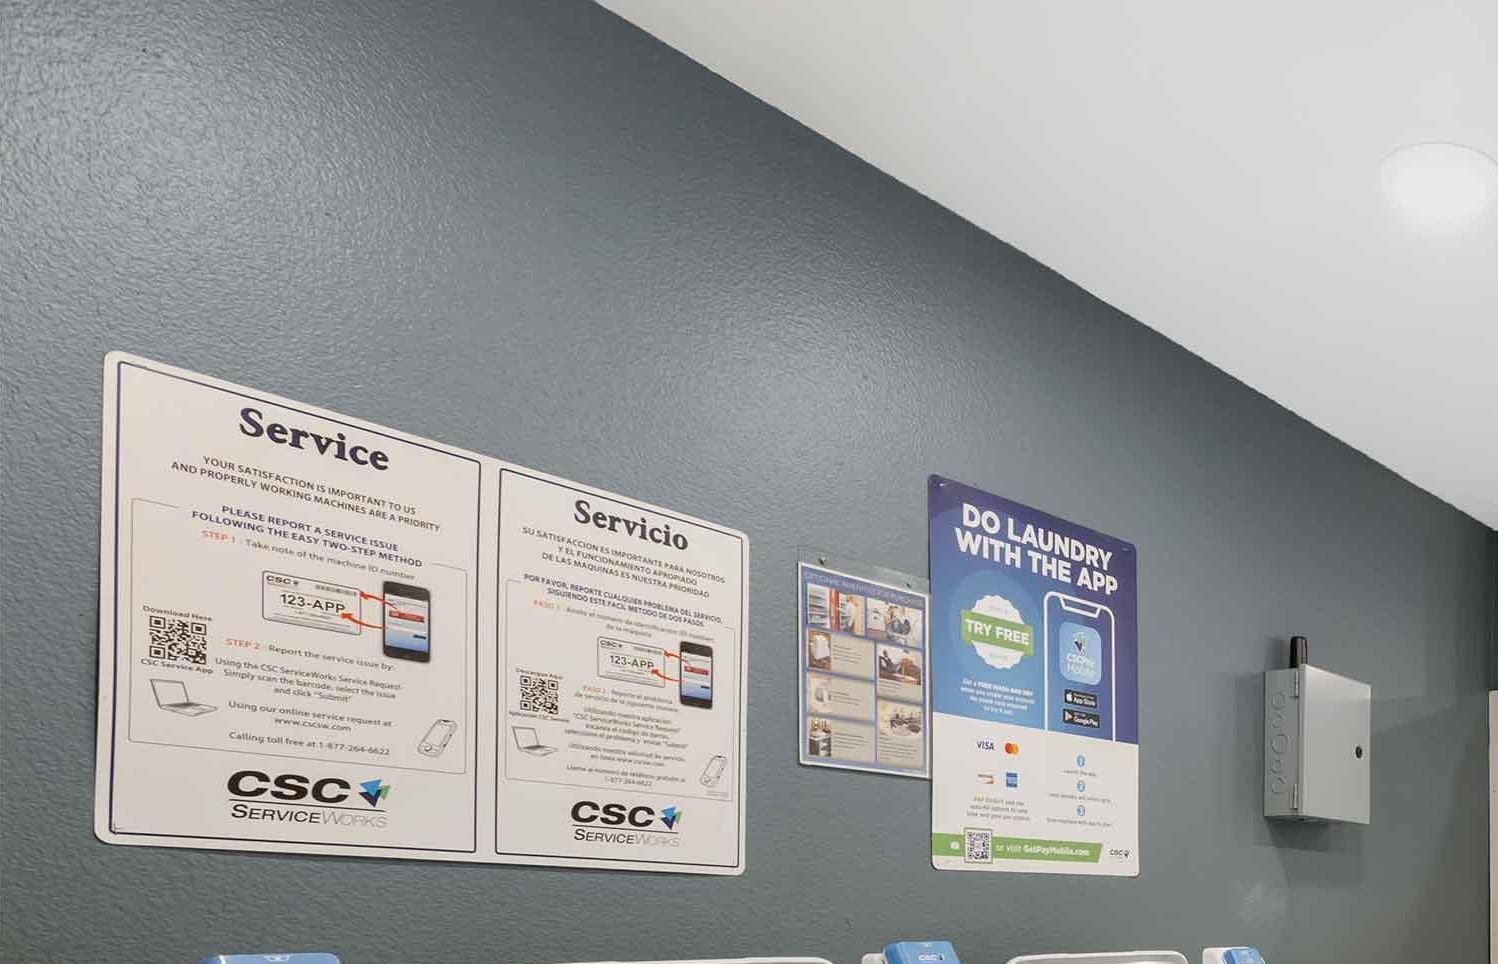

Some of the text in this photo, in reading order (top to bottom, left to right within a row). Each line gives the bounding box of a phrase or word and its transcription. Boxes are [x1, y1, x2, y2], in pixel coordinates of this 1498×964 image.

[239, 405, 388, 471] Service
[171, 461, 439, 531] AND PROPERLY WORKING MACHINES ARE A PRIORITY
[204, 456, 415, 514] YOUR SATISFACTION IS IMPORTANT TO US
[192, 511, 421, 567] FOLLOWING THE EASY TWO-STEP METHOD
[221, 505, 398, 551] PLEASE REPORT A SERVICE ISSUE
[574, 498, 687, 551] Servicio
[962, 502, 1112, 572] DO LAUNDRY
[202, 530, 226, 542] STEP
[246, 539, 267, 550] Take
[271, 544, 294, 556] note
[296, 549, 306, 558] of
[309, 552, 323, 562] the
[327, 556, 366, 570] machine
[368, 564, 377, 573] ID
[380, 567, 414, 580] number
[523, 526, 534, 535] SU
[600, 546, 609, 554] ES
[611, 549, 661, 568] IMPORTANTE
[664, 562, 683, 573] PARA
[686, 568, 724, 583] NOSOTROS
[558, 545, 696, 586] Y EL FUNCIONAMIENTO APROPIADO
[955, 527, 1117, 597] WITH THE APP
[266, 575, 290, 584] CSC
[542, 552, 552, 560] DE
[555, 555, 571, 565] LAS
[621, 571, 629, 579] ES
[632, 574, 666, 588] NUESTRA
[668, 582, 709, 598] PRIORIDAD
[280, 593, 345, 614] 123-APP
[524, 573, 539, 582] POR
[570, 583, 601, 596] REPORTE
[603, 591, 642, 605] CUALQUIER
[643, 600, 678, 613] PROBLEMA
[680, 608, 690, 616] DEL
[547, 587, 588, 602] SIGUIENDO
[590, 596, 604, 605] ESTE
[668, 614, 681, 622] DOS
[143, 605, 212, 621] Download Here
[965, 618, 1028, 646] TRY FREE
[140, 658, 212, 674] CSC Service App
[226, 638, 252, 648] STEP
[268, 645, 301, 657] Report
[322, 653, 353, 664] service
[357, 659, 378, 667] issue
[610, 654, 653, 670] 123-APP
[215, 657, 241, 669] Using
[244, 662, 258, 670] the
[260, 664, 278, 672] CSC
[338, 675, 367, 685] Service
[223, 668, 254, 680] Simply
[258, 674, 277, 682] scan
[280, 677, 293, 685] the
[335, 685, 358, 694] select
[361, 688, 373, 696] the
[376, 690, 395, 699] issue
[274, 686, 290, 694] and
[292, 688, 310, 697] click
[228, 701, 257, 711] Using
[259, 705, 277, 713] our
[279, 707, 309, 717] online
[312, 711, 344, 721] service
[347, 716, 380, 726] request
[229, 731, 264, 743] Calling
[267, 736, 282, 744] toll
[285, 738, 304, 746] free
[977, 740, 994, 750] VISA
[228, 768, 350, 804] CSC
[571, 799, 654, 828] CSC
